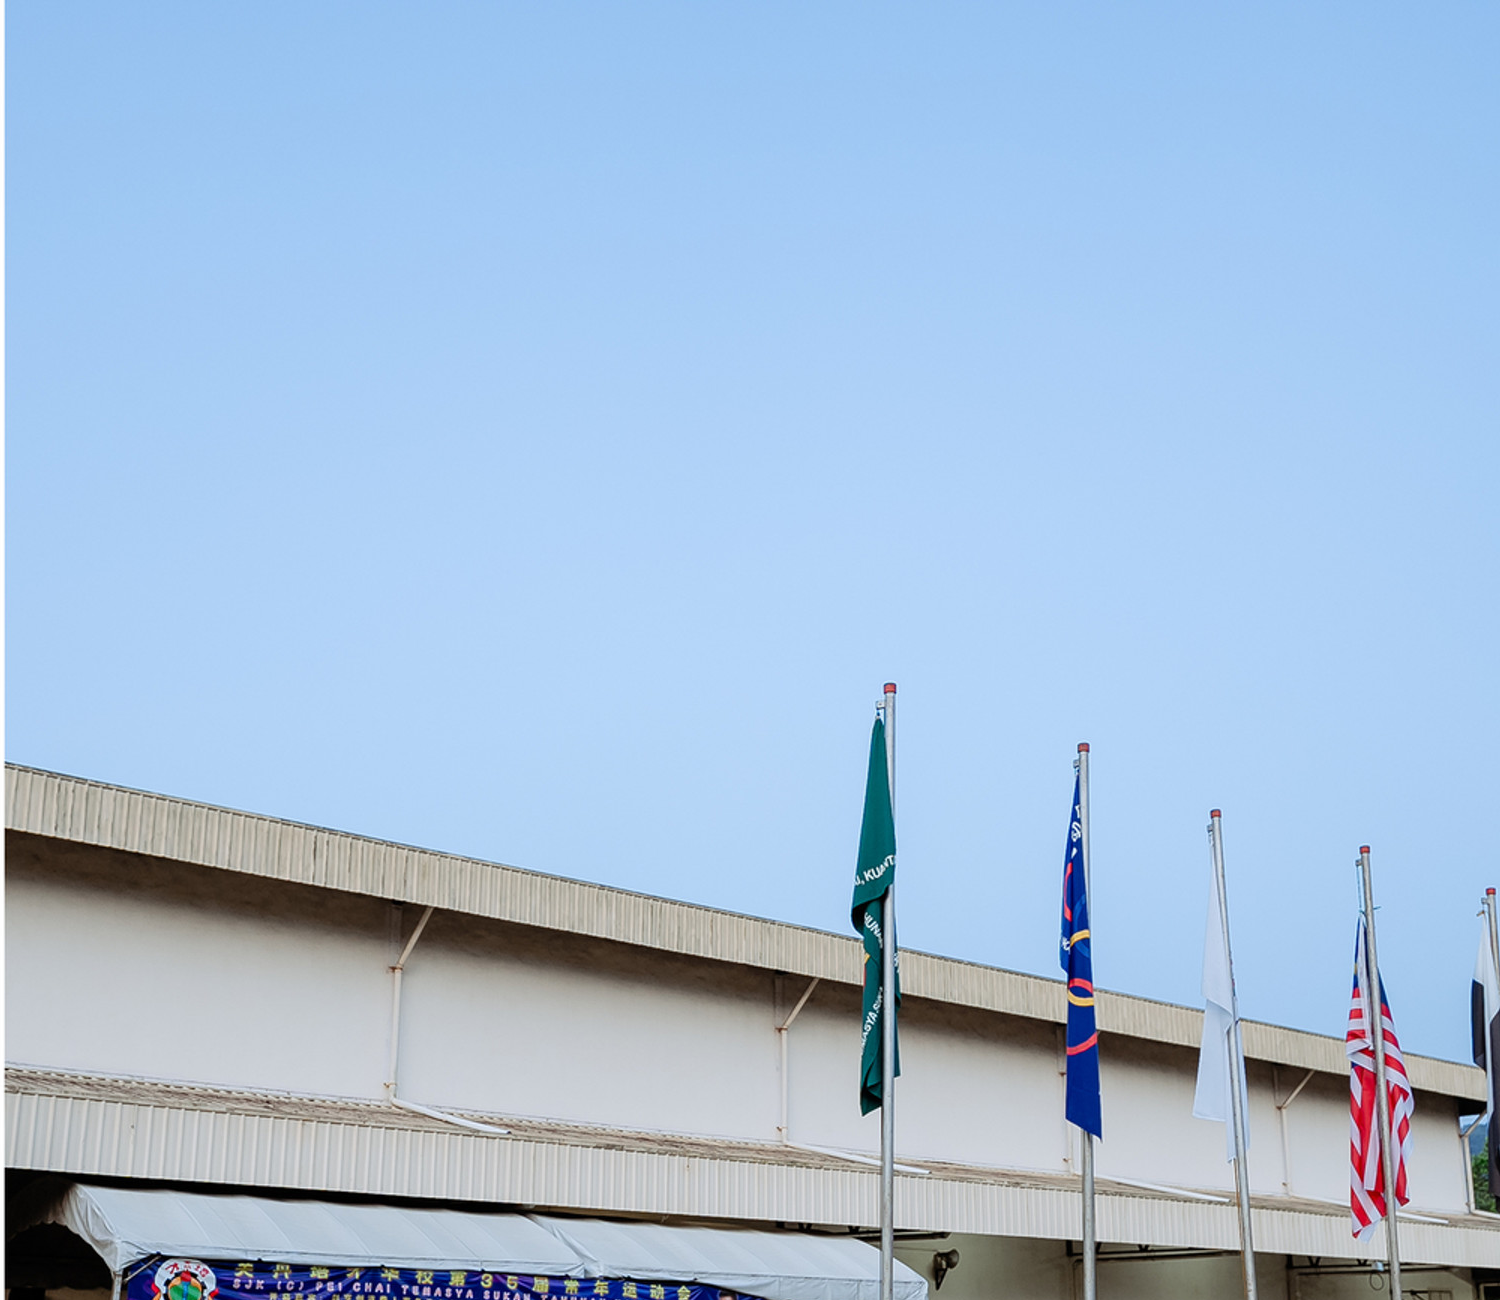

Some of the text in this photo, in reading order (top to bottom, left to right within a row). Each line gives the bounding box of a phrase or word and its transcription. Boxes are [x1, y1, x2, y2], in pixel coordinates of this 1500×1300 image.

[232, 1279, 265, 1290] SJK
[276, 1280, 304, 1291] (C)
[315, 1281, 343, 1292] PEI
[352, 1282, 391, 1294] CHAI
[400, 1284, 474, 1299] TEMASYA
